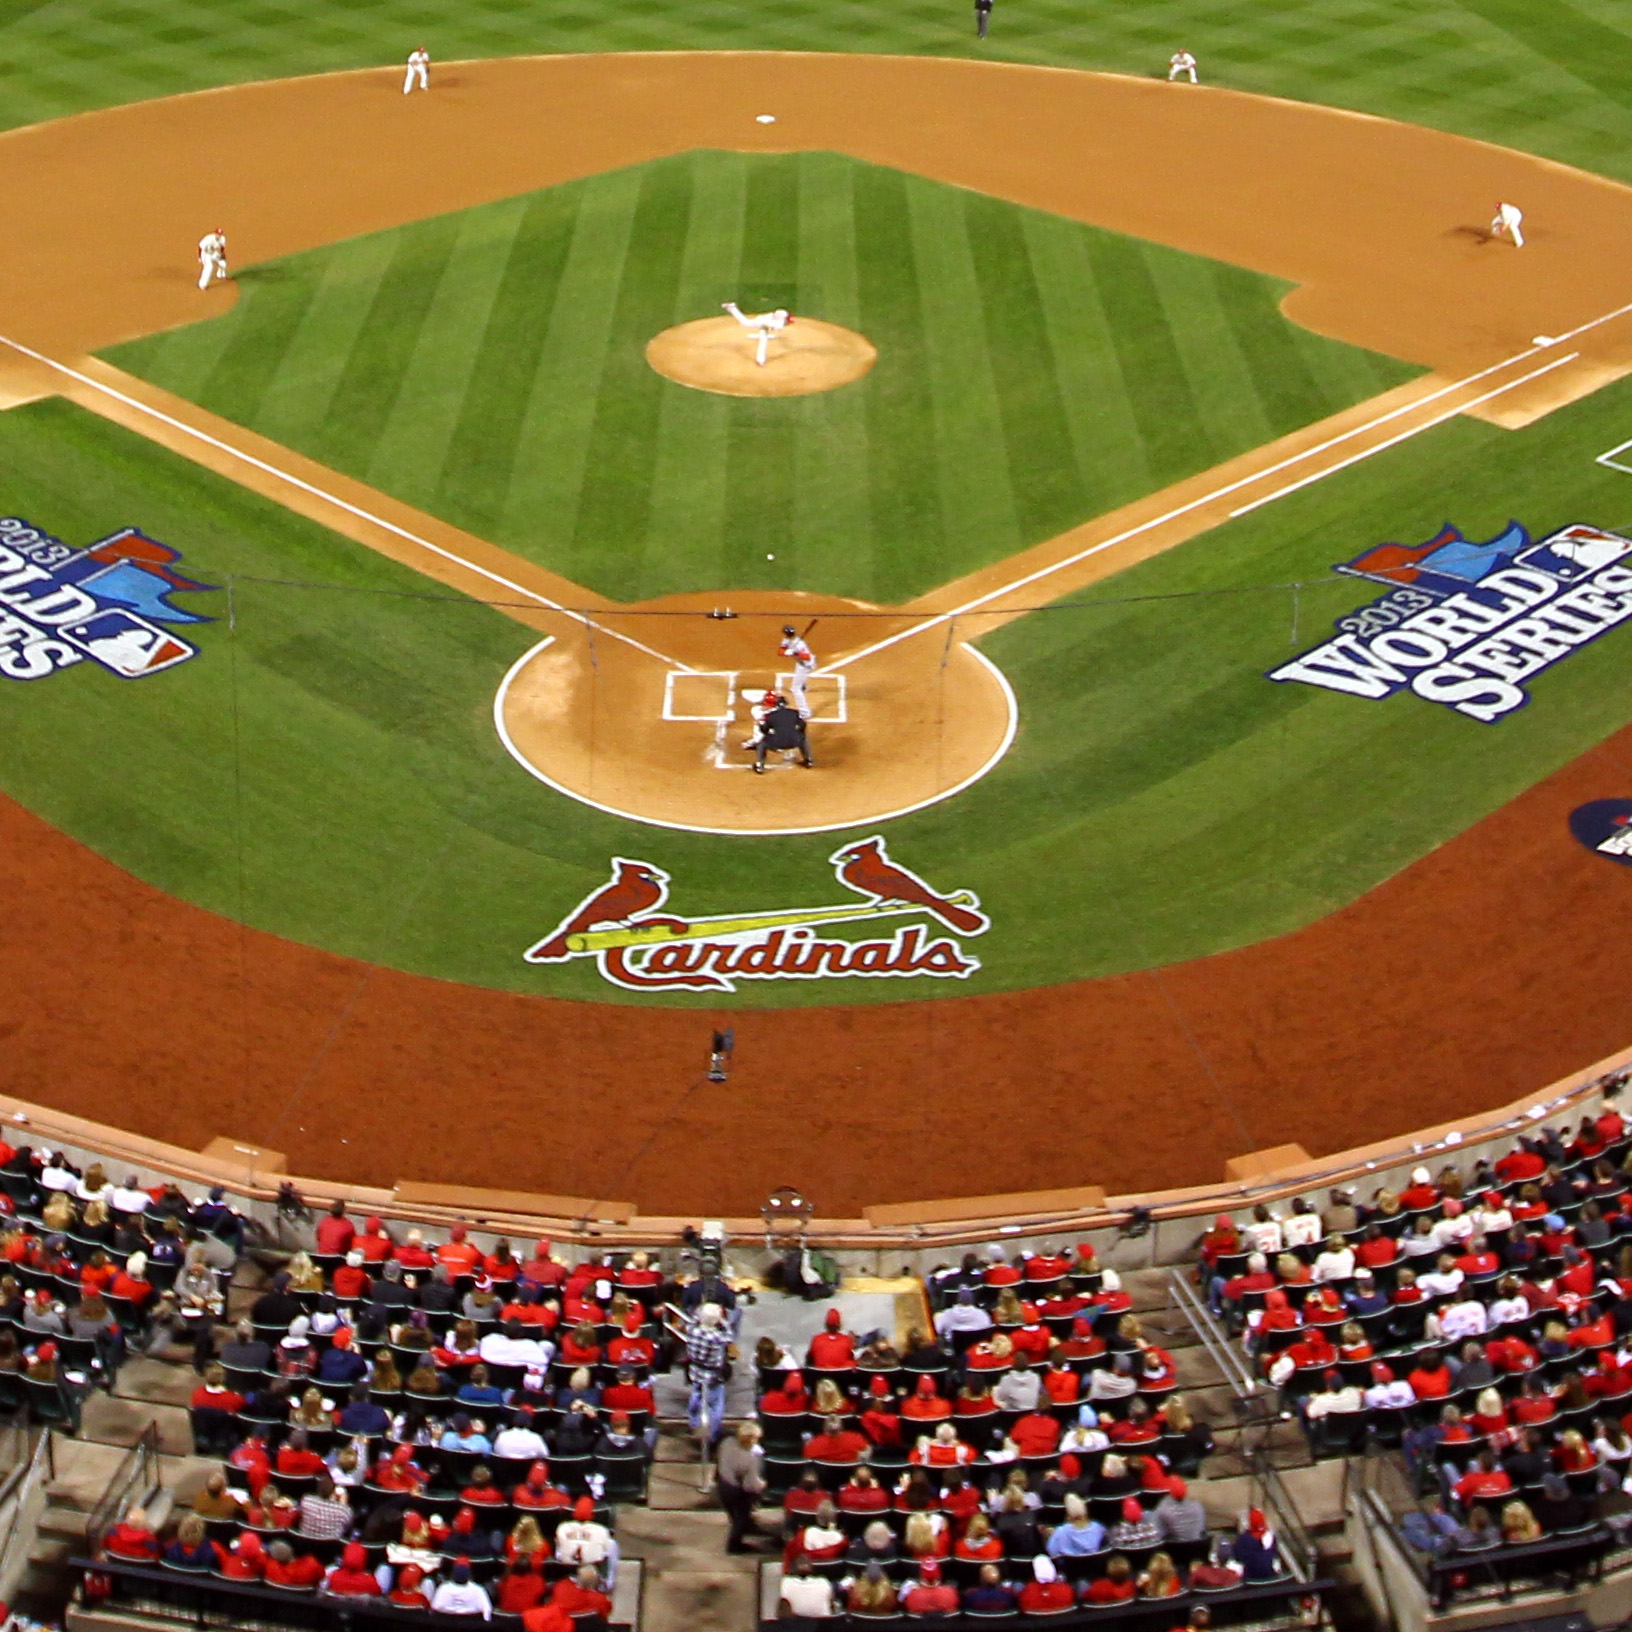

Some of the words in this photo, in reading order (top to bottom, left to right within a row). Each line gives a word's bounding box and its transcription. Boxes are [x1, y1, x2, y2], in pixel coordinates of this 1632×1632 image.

[1269, 569, 1559, 700] WORLD
[1340, 589, 1434, 638] 2013
[601, 917, 979, 990] Cardinals
